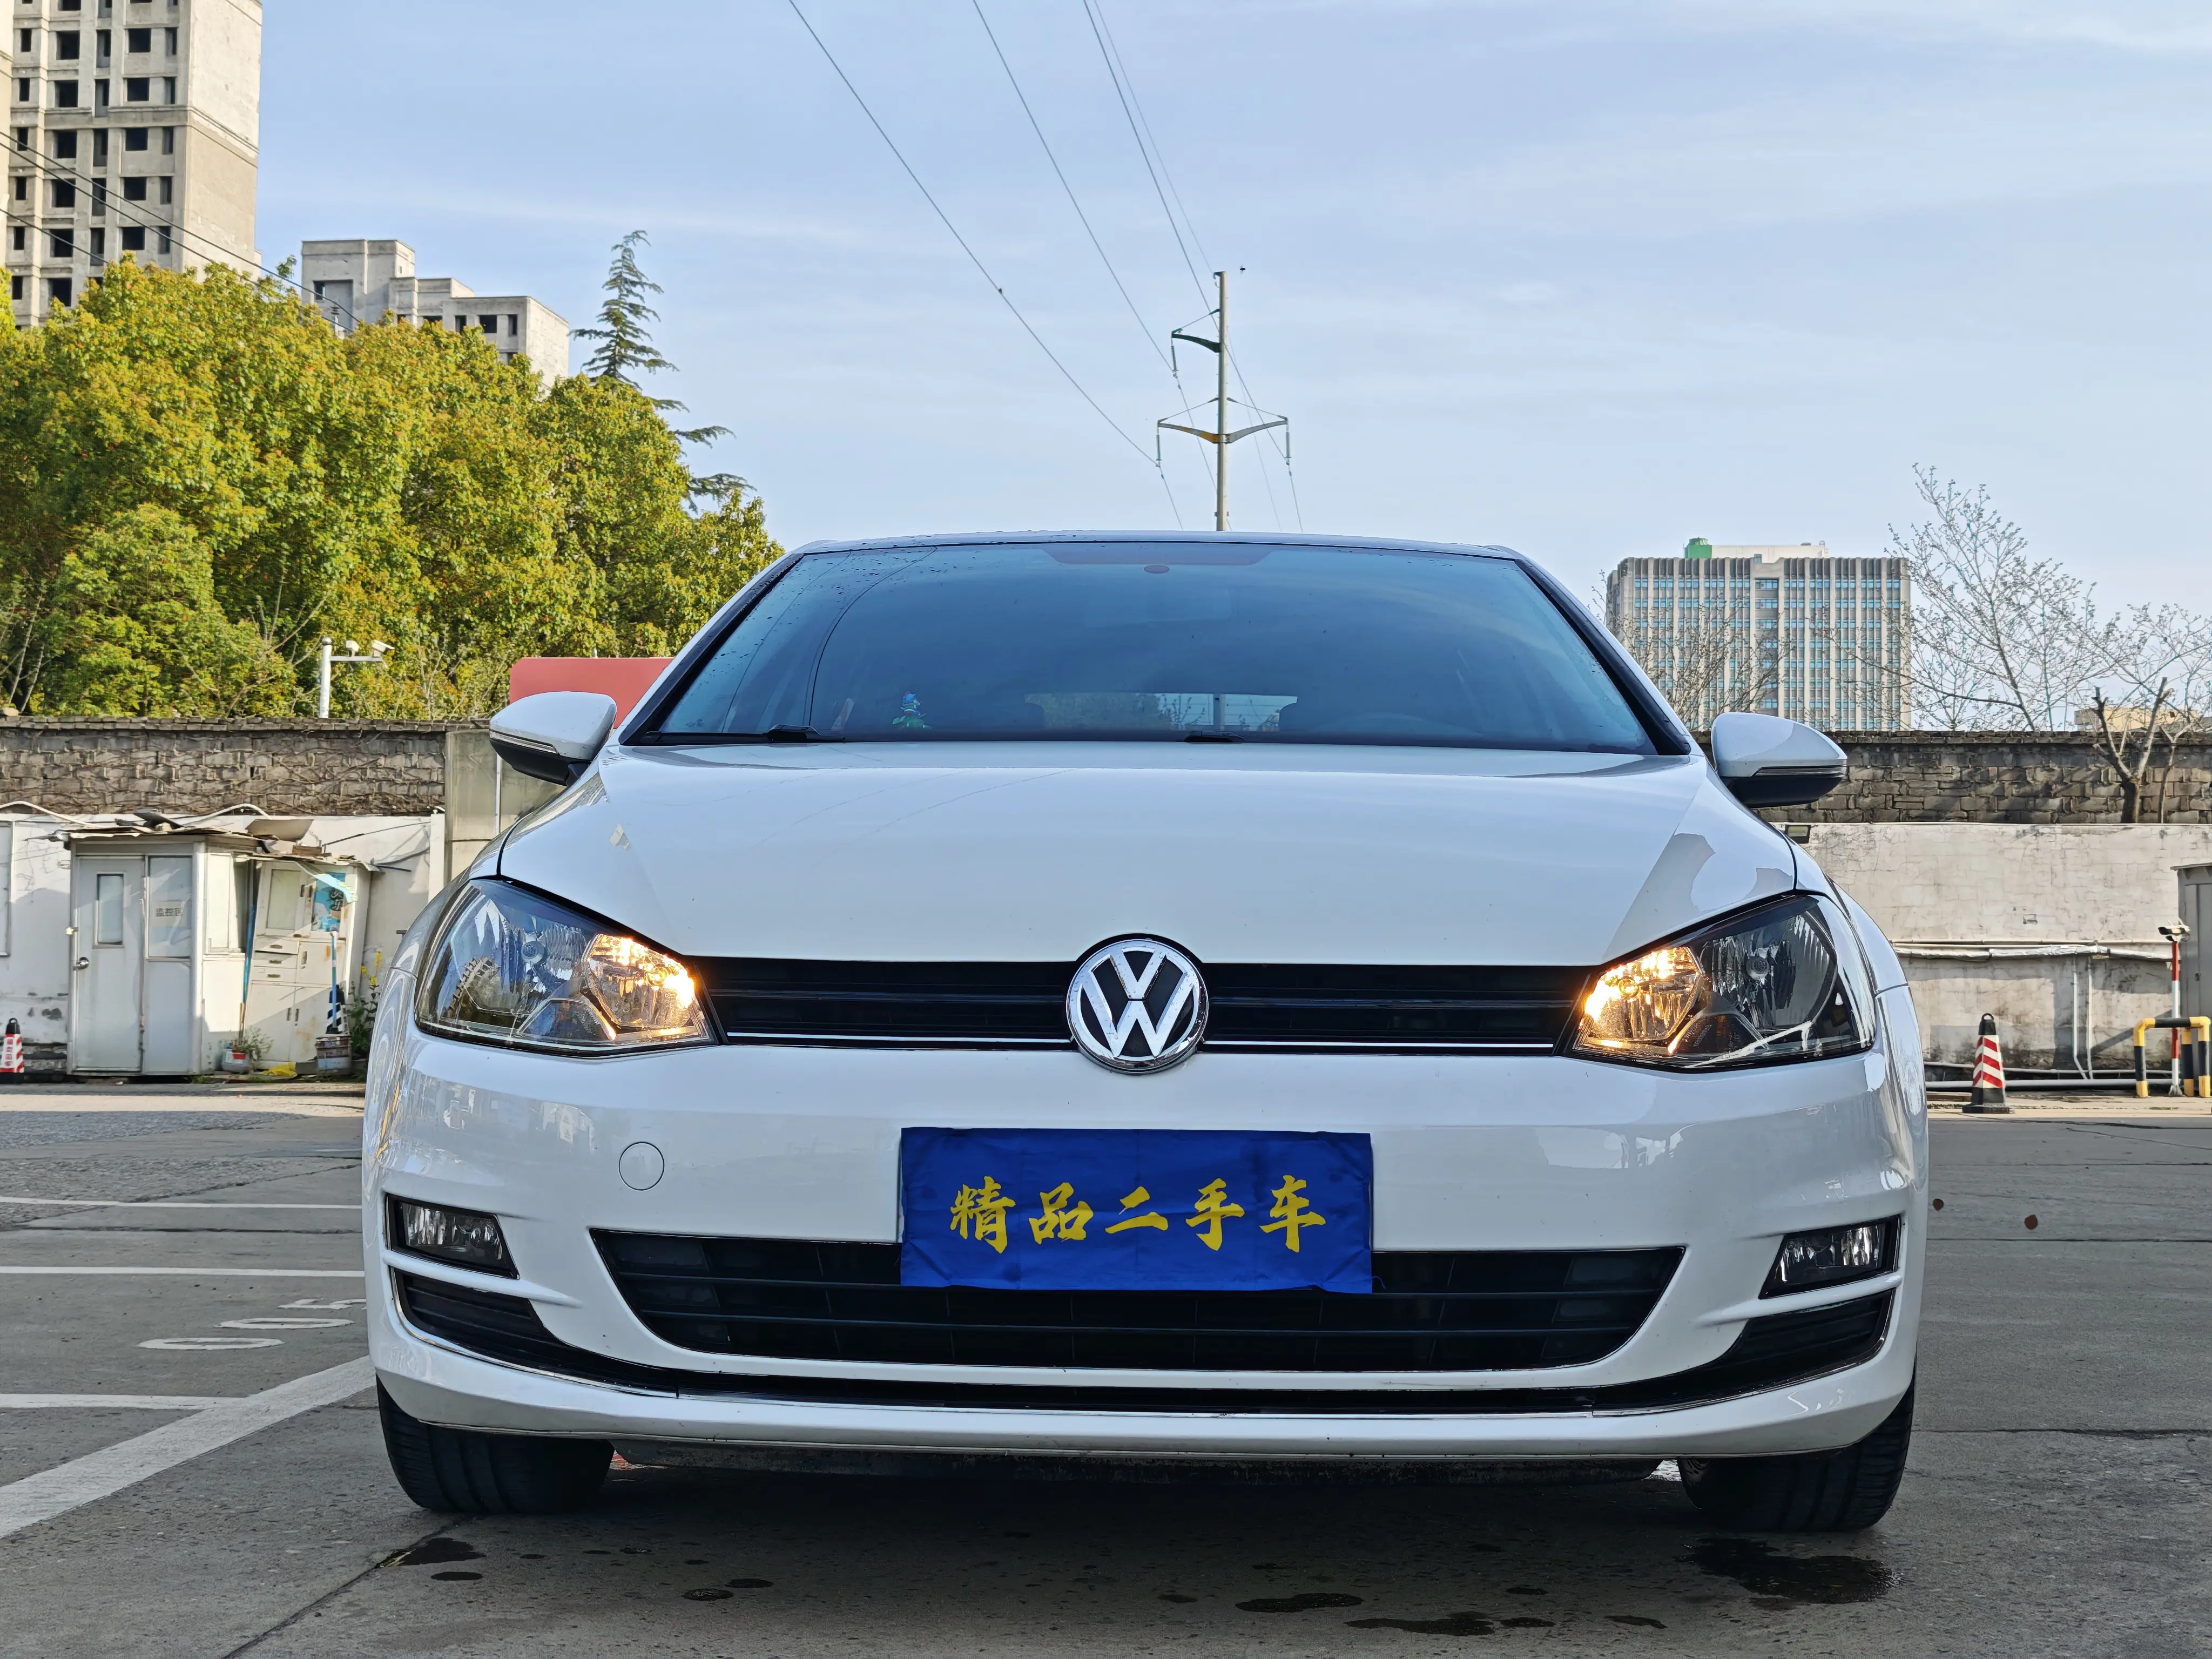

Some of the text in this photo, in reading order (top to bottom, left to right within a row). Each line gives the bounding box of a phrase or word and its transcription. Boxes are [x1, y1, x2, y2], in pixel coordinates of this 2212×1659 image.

[950, 1175, 1326, 1253] 精品二手车
